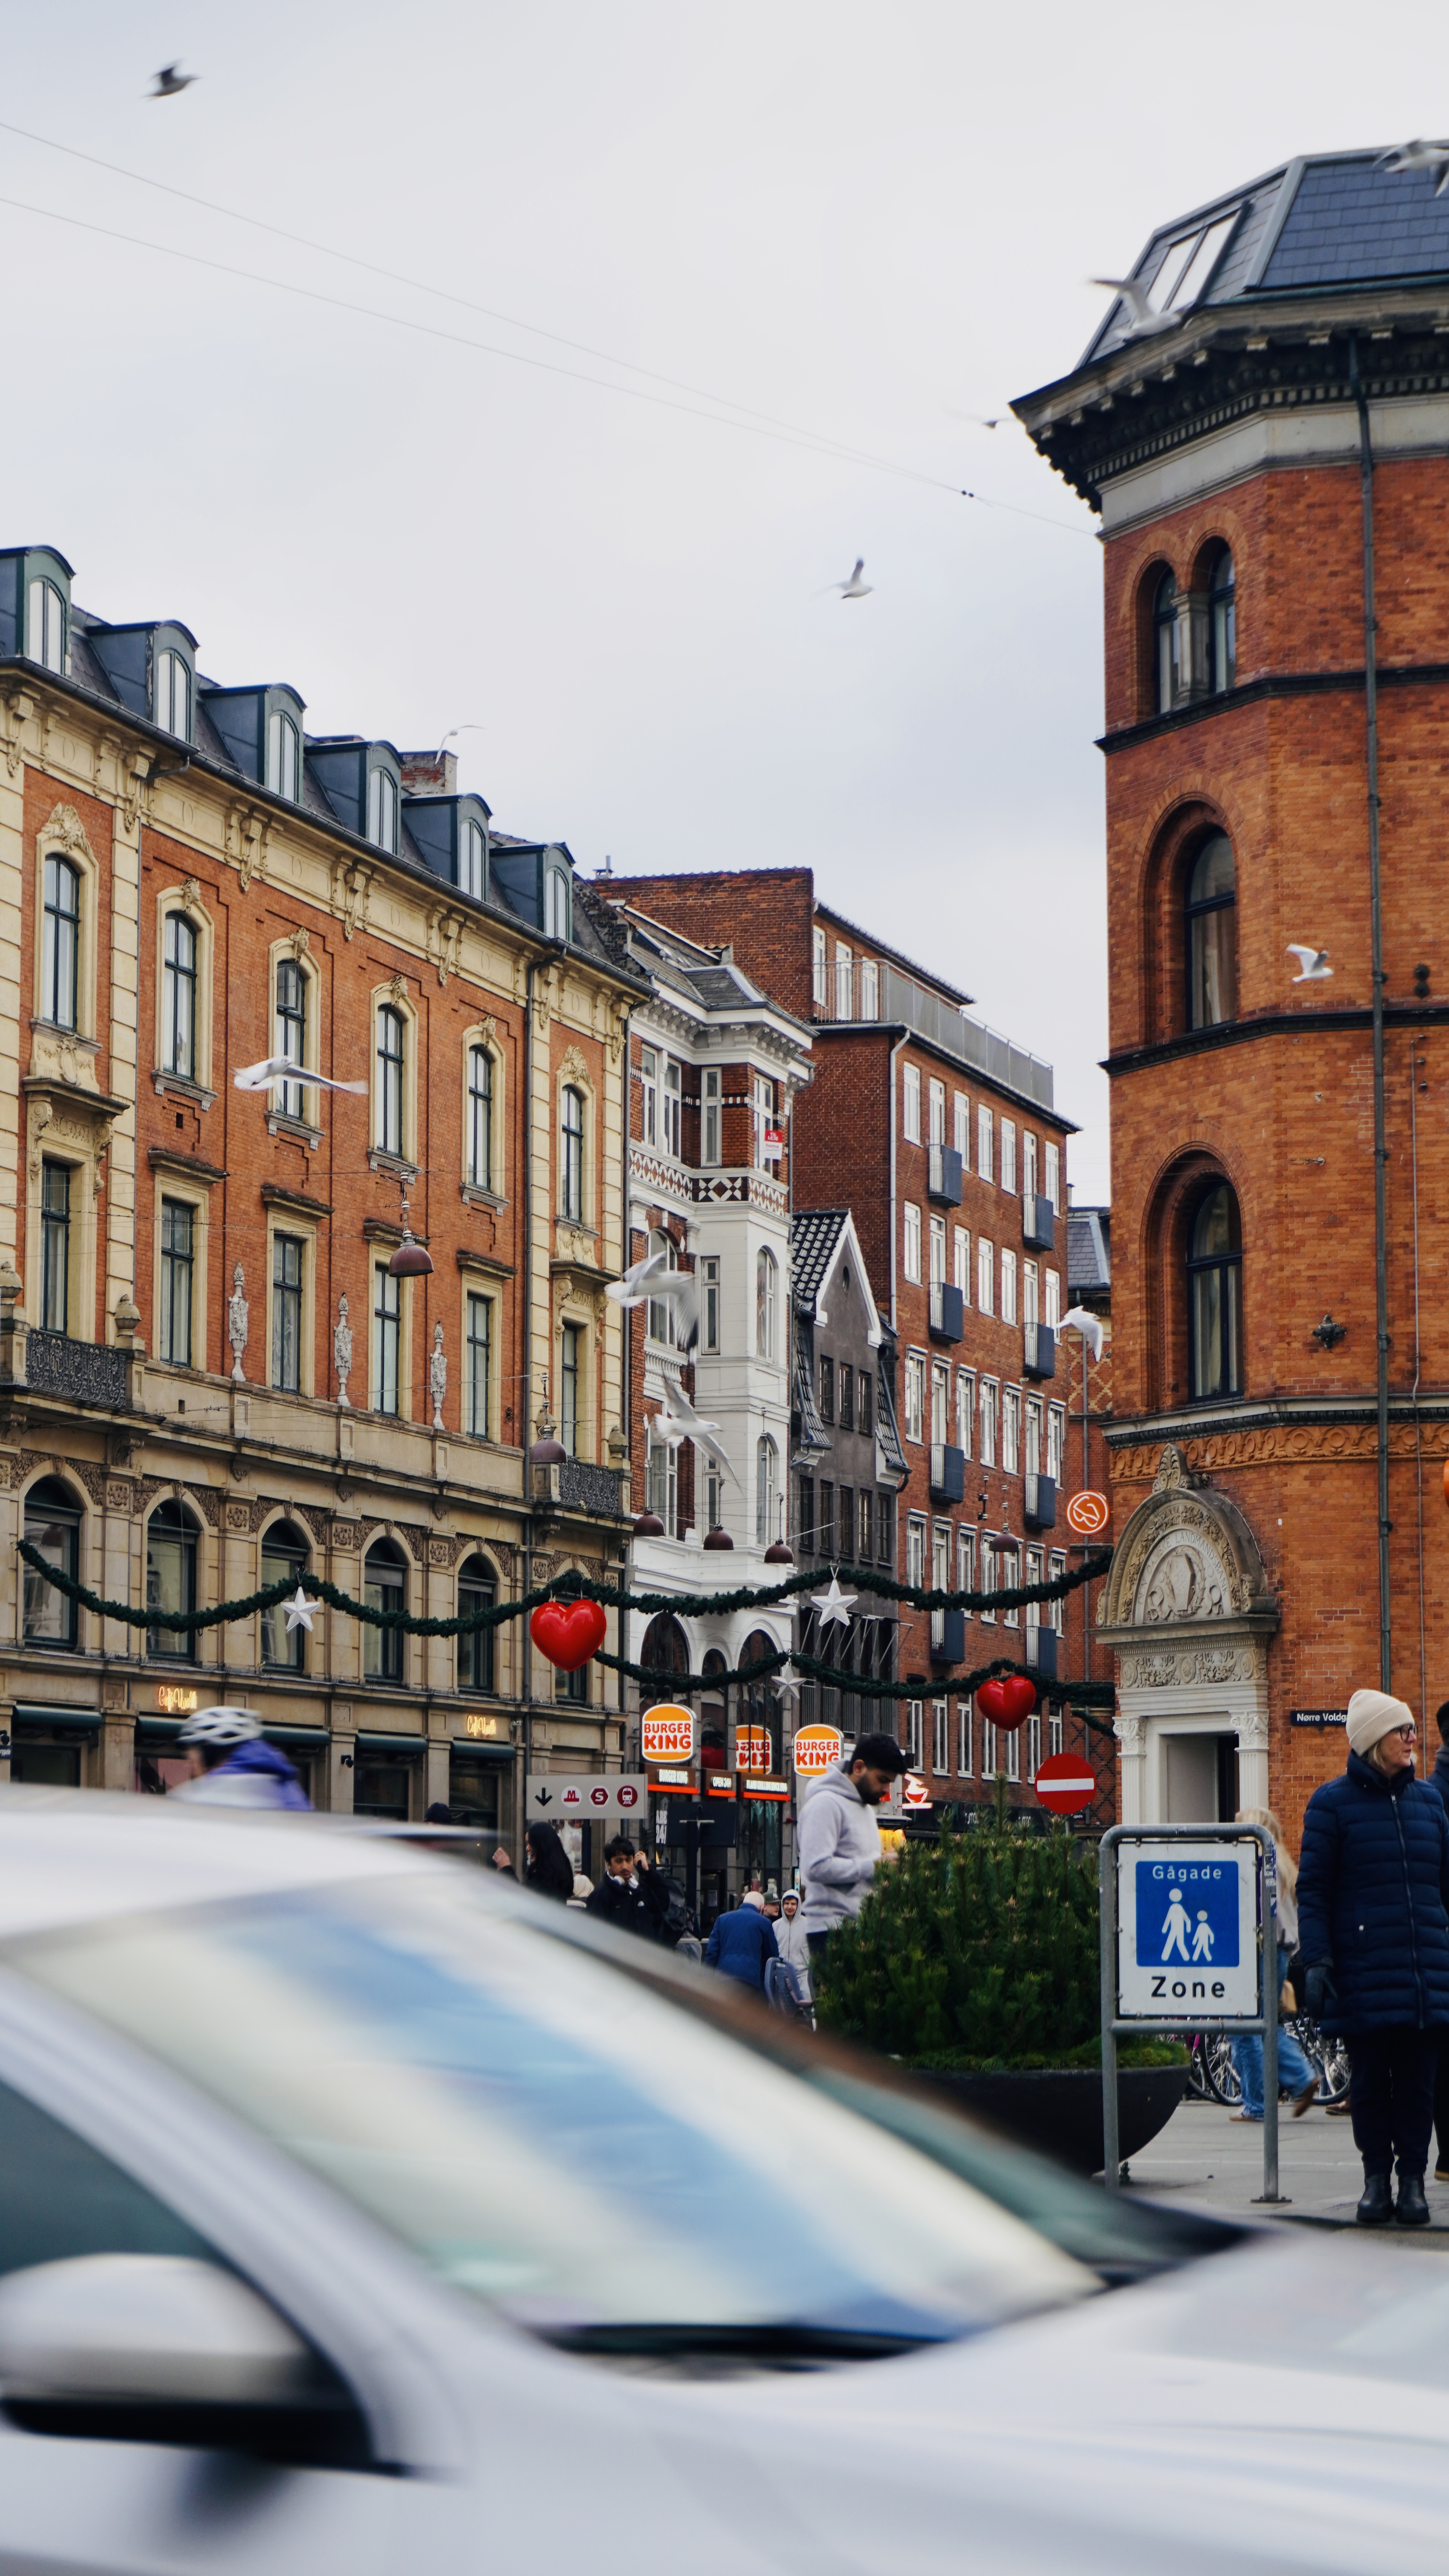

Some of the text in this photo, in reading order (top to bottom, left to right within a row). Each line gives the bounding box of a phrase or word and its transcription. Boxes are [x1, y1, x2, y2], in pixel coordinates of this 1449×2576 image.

[1175, 1532, 1228, 1596] LANDMANDSBANK
[1297, 1712, 1348, 1722] Nørre Voldg
[644, 1723, 691, 1733] BURGER
[644, 1735, 691, 1750] KING
[796, 1742, 839, 1751] BURGER
[796, 1752, 839, 1766] KING
[659, 1769, 688, 1784] BURGER KING
[713, 1776, 724, 1787] OPEN
[595, 1791, 604, 1802] S
[1152, 1865, 1221, 1882] Gågade
[1151, 1976, 1225, 1998] Zone
